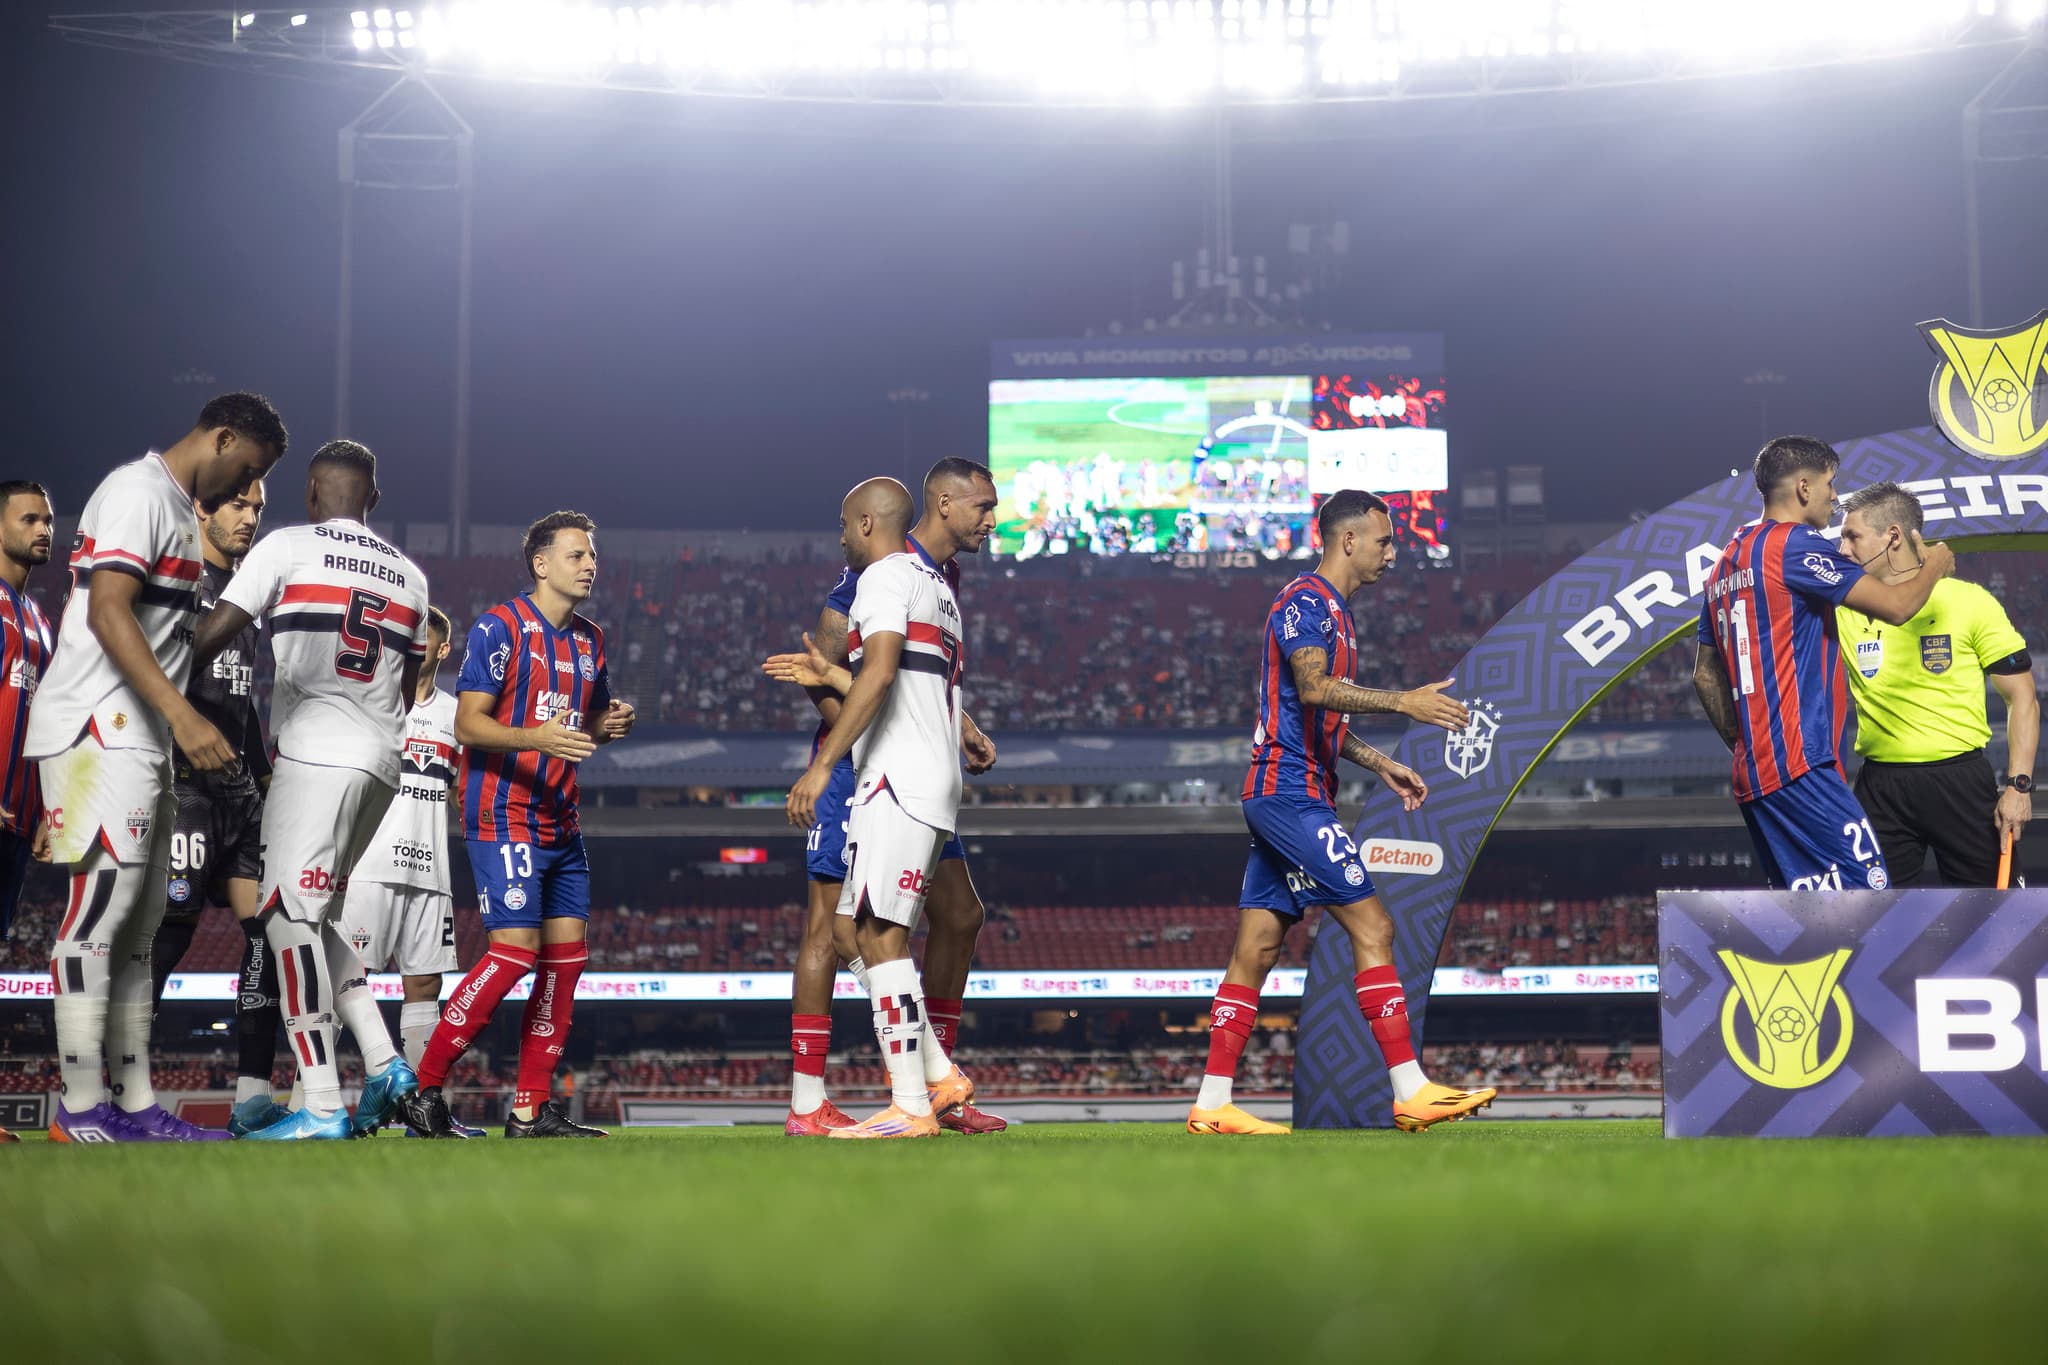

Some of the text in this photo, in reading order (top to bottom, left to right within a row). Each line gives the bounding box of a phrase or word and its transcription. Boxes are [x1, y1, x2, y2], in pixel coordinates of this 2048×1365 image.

[1012, 351, 1079, 367] VIVA
[1083, 347, 1249, 366] MOMENTOS
[314, 526, 406, 562] SUPERBE
[324, 554, 406, 589] ARBOLEDA
[936, 594, 959, 624] LUCAS
[335, 586, 392, 684] 5
[1857, 642, 1881, 654] FIFA
[1925, 637, 1947, 647] CBF
[536, 689, 570, 710] VIVA
[410, 744, 436, 755] SPFC
[1459, 737, 1480, 746] CBF
[127, 818, 150, 828] SPFC
[170, 832, 206, 871] 96
[392, 845, 433, 862] TODOS
[1317, 823, 1358, 864] 25
[1843, 818, 1881, 862] 21
[393, 860, 431, 873] SONHOS
[499, 843, 533, 880] 13
[1369, 846, 1434, 868] Betano
[245, 937, 265, 990] UniCesumar
[456, 961, 501, 1011] UniCesumar
[537, 970, 558, 1021] UniCesumar
